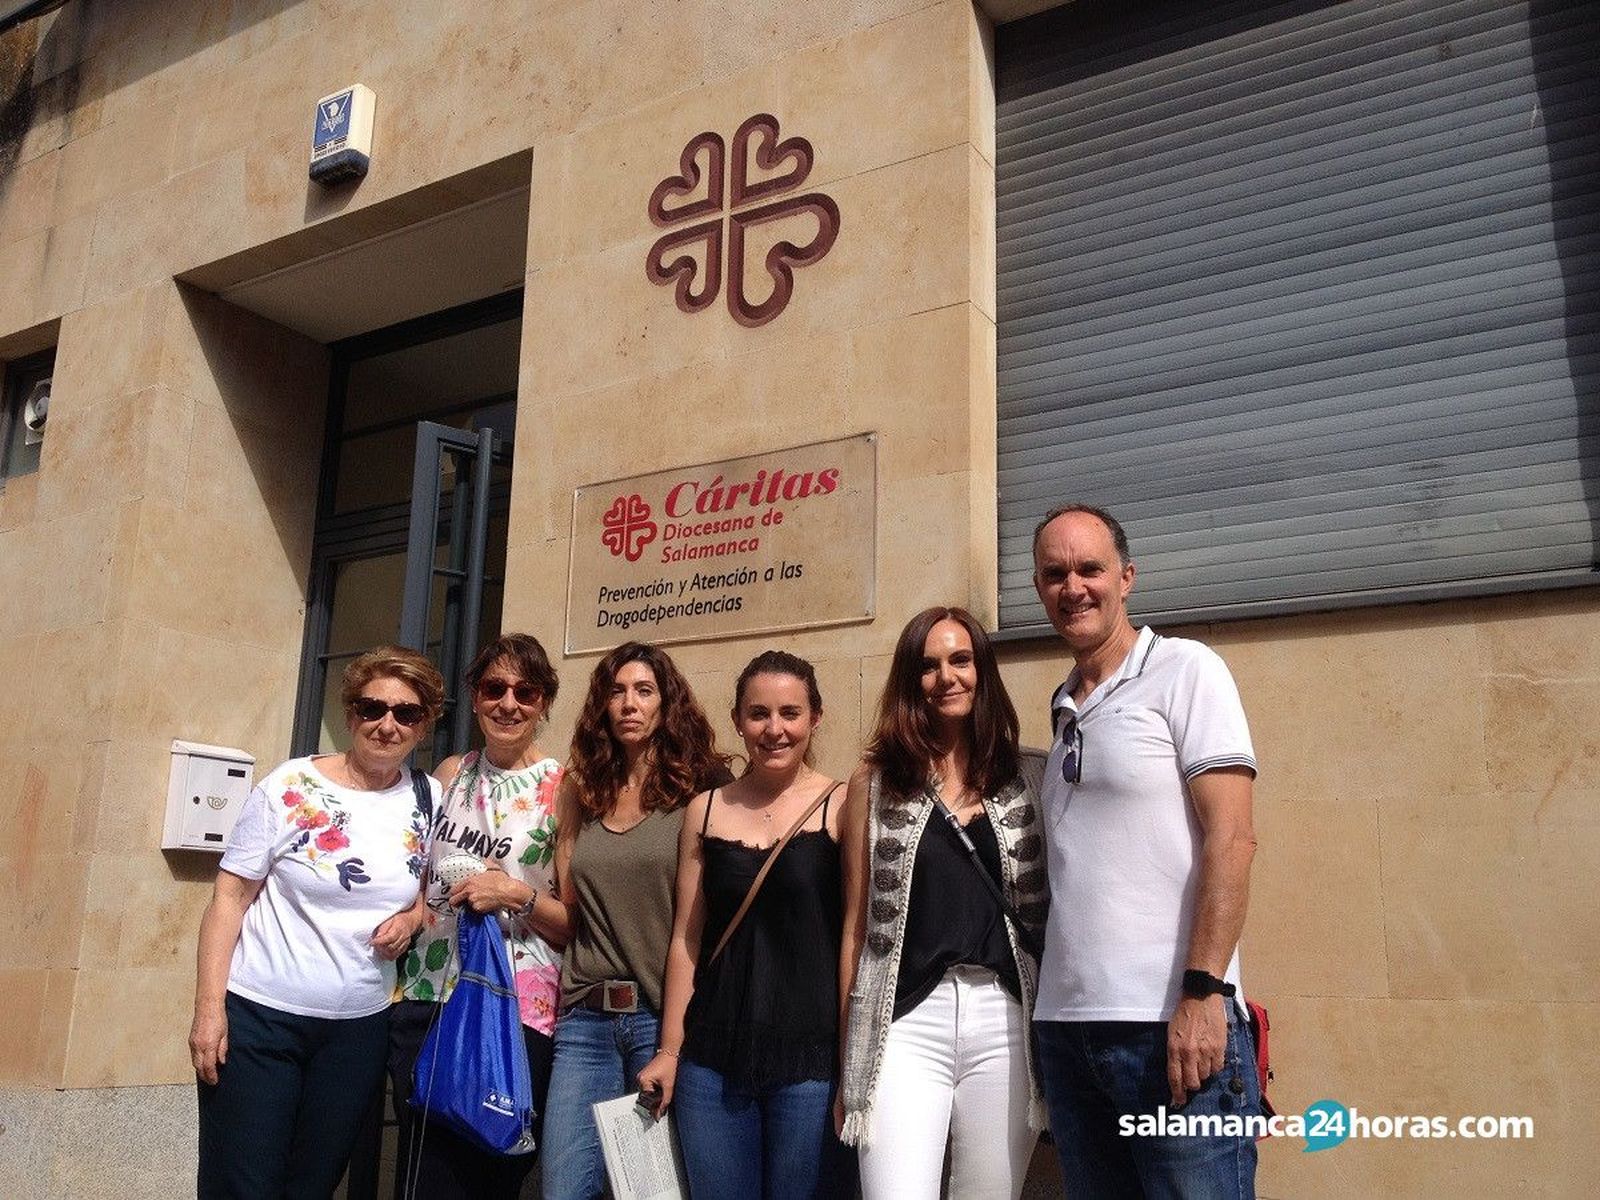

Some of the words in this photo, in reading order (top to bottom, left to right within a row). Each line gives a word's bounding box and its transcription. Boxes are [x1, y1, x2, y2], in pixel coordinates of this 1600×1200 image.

[664, 467, 840, 518] Cáritas
[662, 513, 754, 541] Diocesana
[761, 507, 784, 526] de
[661, 537, 760, 564] Salamanca
[598, 578, 673, 604] Prevención
[678, 578, 688, 598] y
[690, 566, 757, 592] Atención
[763, 568, 774, 582] a
[780, 560, 803, 580] las
[597, 594, 743, 630] Drogodependencias
[435, 820, 513, 860] ALWAYS
